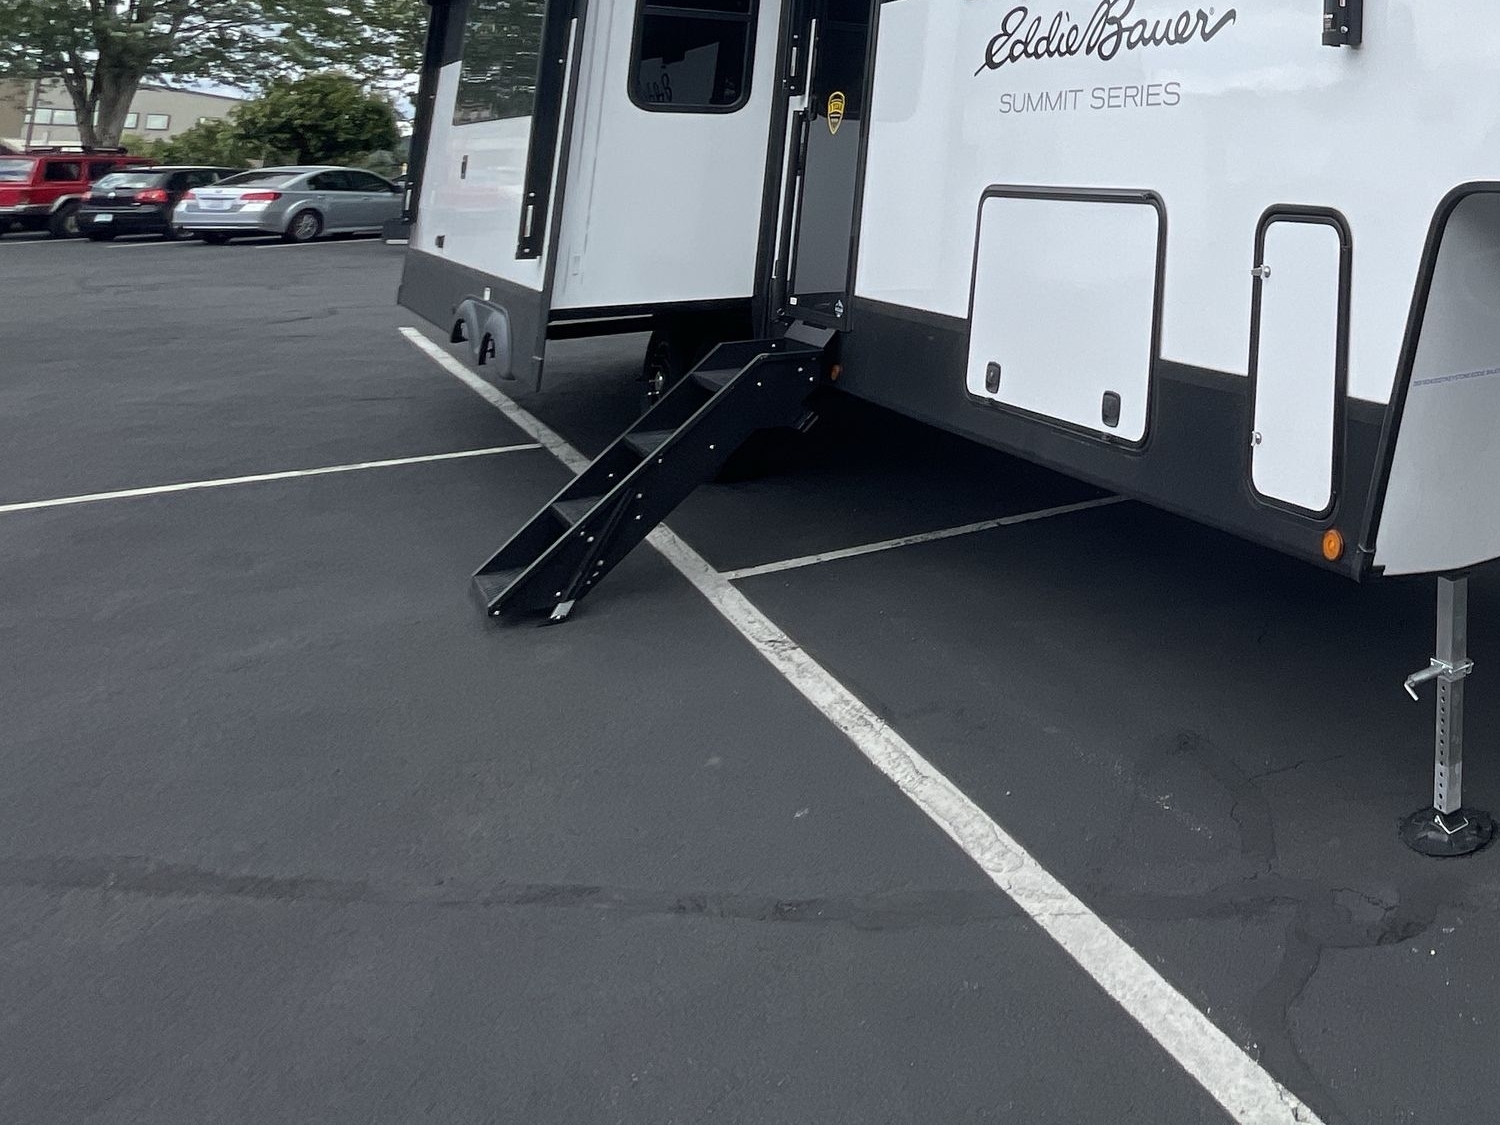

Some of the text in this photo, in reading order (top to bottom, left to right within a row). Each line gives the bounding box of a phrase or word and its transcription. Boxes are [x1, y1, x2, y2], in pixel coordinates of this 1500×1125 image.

[974, 6, 1081, 77] Eddie
[999, 81, 1181, 114] SUMMIT SERIES
